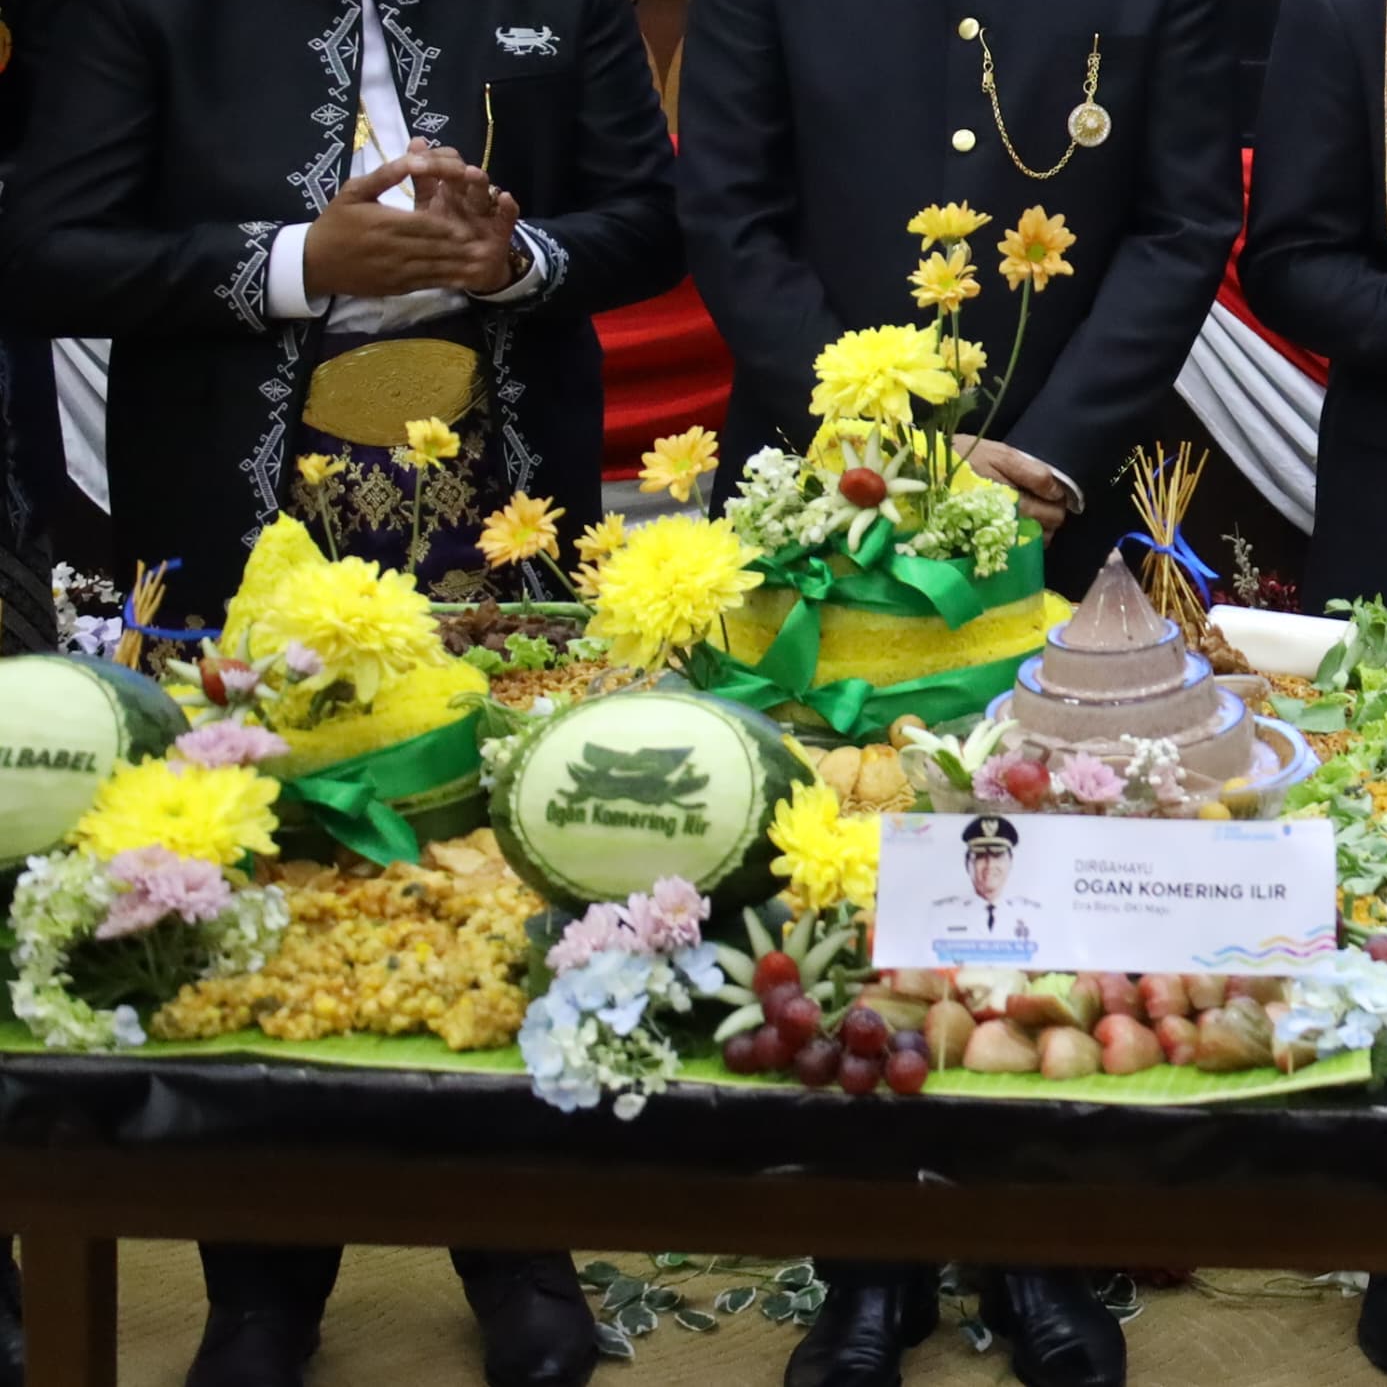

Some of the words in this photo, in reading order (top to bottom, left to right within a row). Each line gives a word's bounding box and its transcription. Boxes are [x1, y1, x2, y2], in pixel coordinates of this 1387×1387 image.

[592, 803, 677, 838] Komering
[1074, 878, 1133, 896] OGAN
[1139, 880, 1243, 900] KOMERING
[1250, 883, 1287, 900] ILIR
